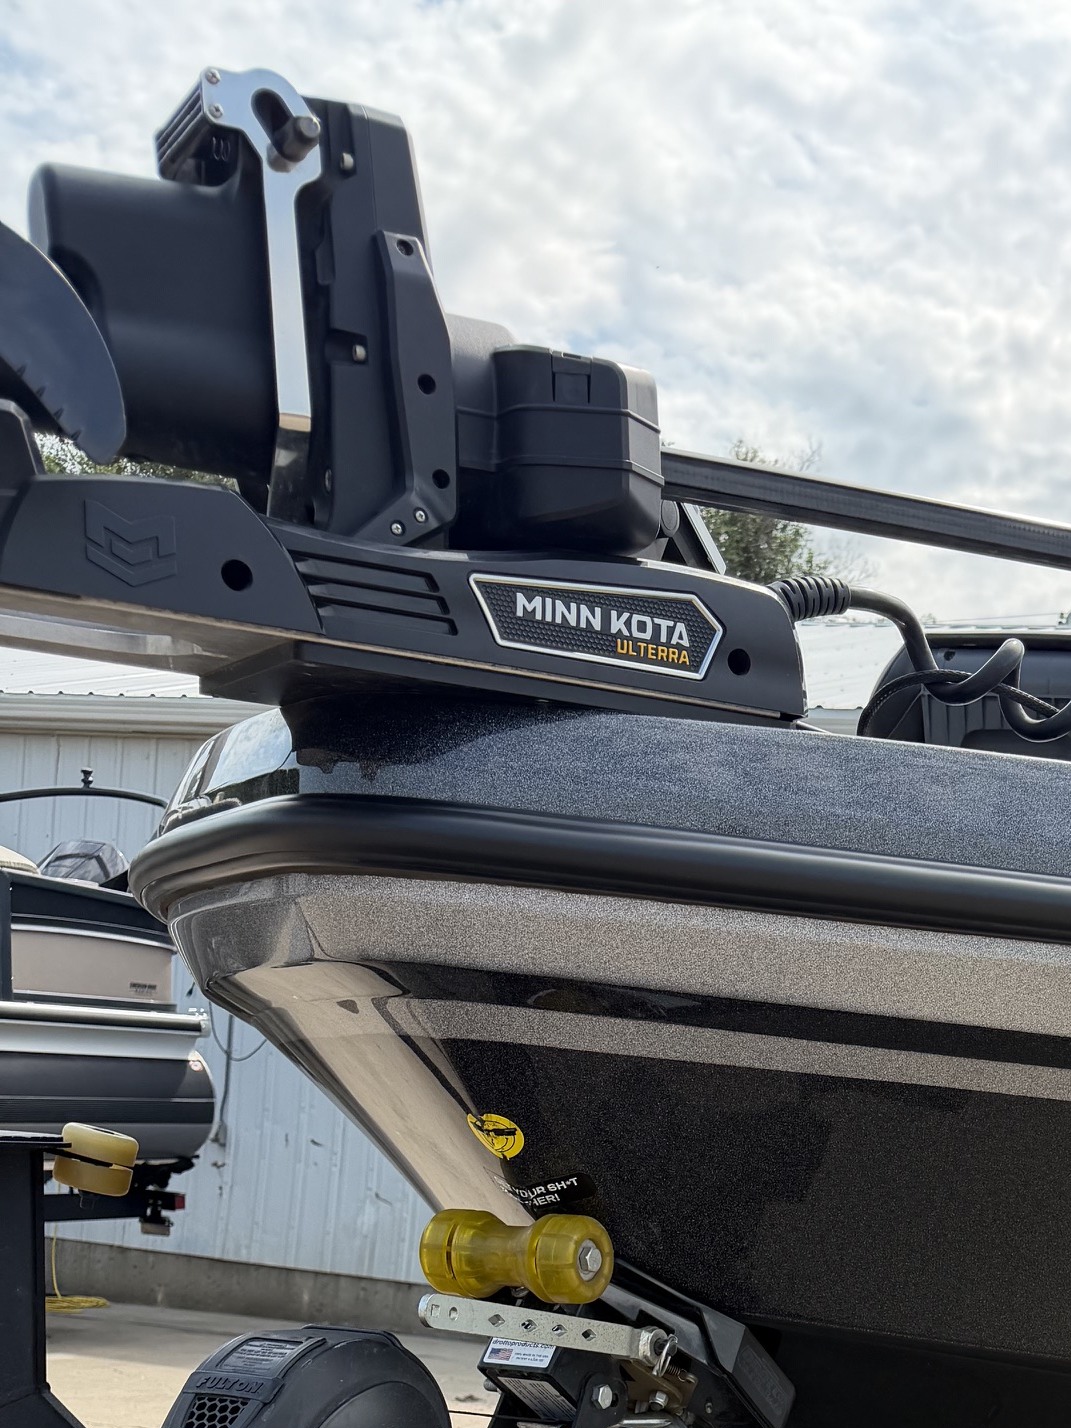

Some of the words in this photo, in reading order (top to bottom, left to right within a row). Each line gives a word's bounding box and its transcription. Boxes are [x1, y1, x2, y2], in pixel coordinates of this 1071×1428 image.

[516, 592, 601, 631] MINN
[610, 610, 690, 648] KOTA
[616, 639, 690, 666] ULTERRA
[196, 1376, 264, 1394] FULTON
